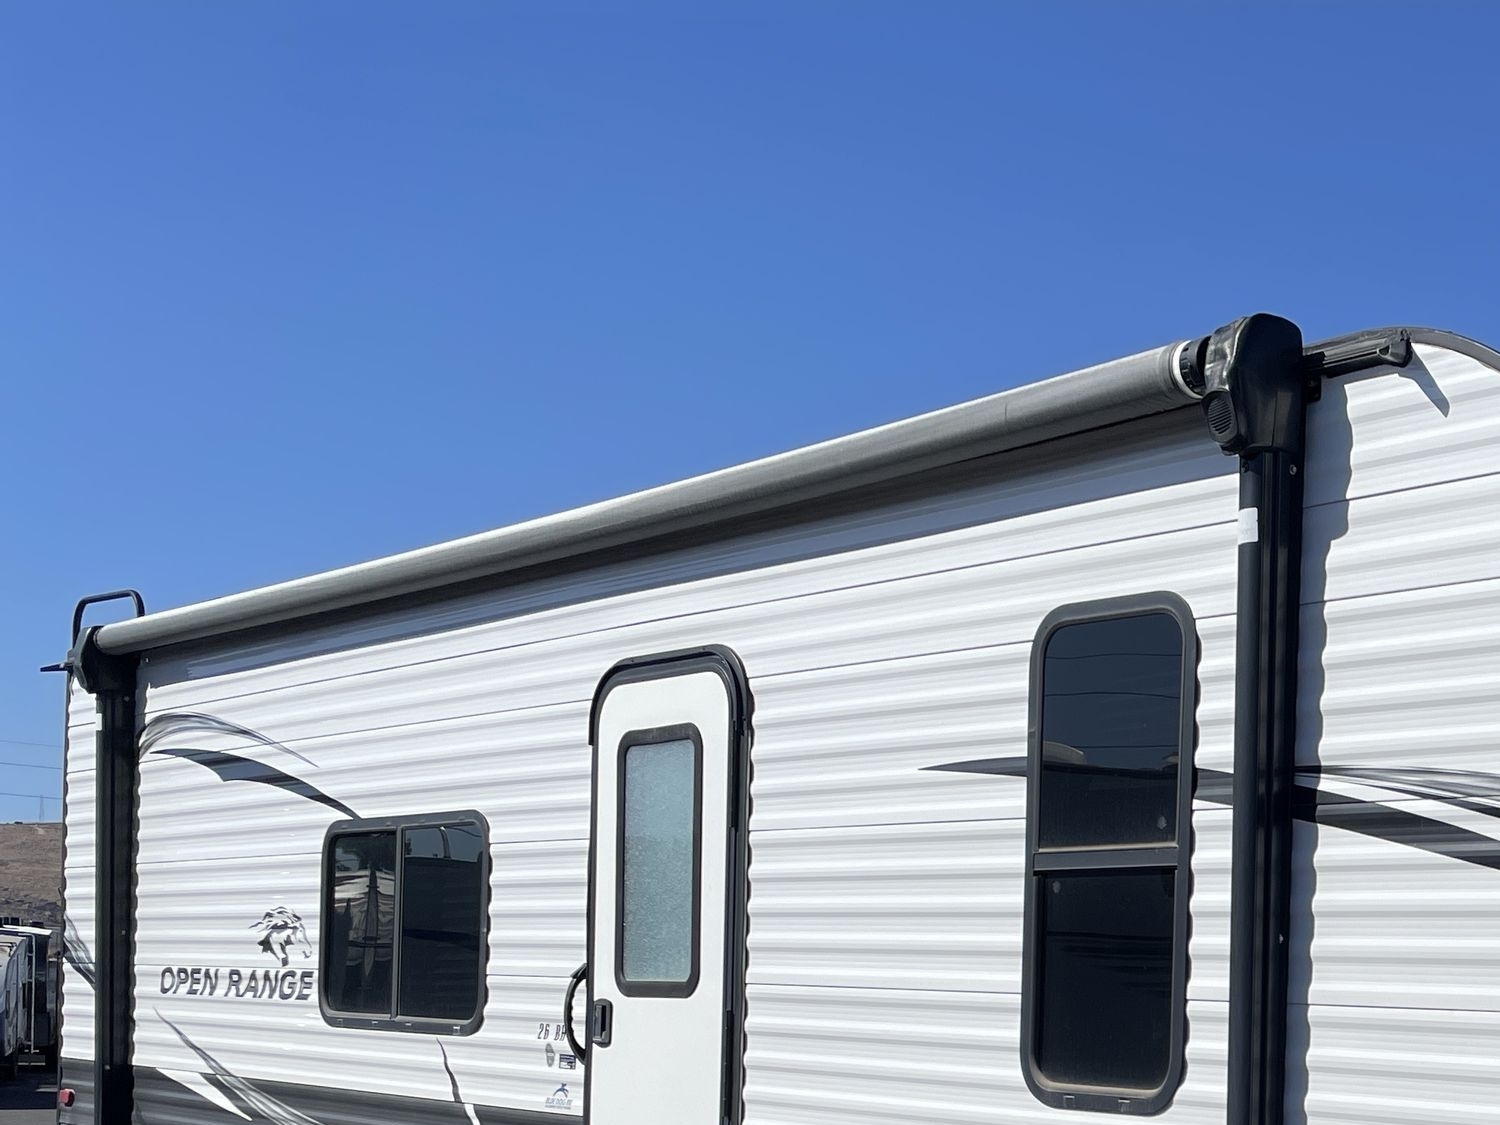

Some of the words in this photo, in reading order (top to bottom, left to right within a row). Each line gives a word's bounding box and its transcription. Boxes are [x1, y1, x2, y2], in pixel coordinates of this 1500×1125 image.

[160, 966, 220, 996] OPEN
[224, 969, 315, 1001] RANGE
[537, 1022, 550, 1040] 26
